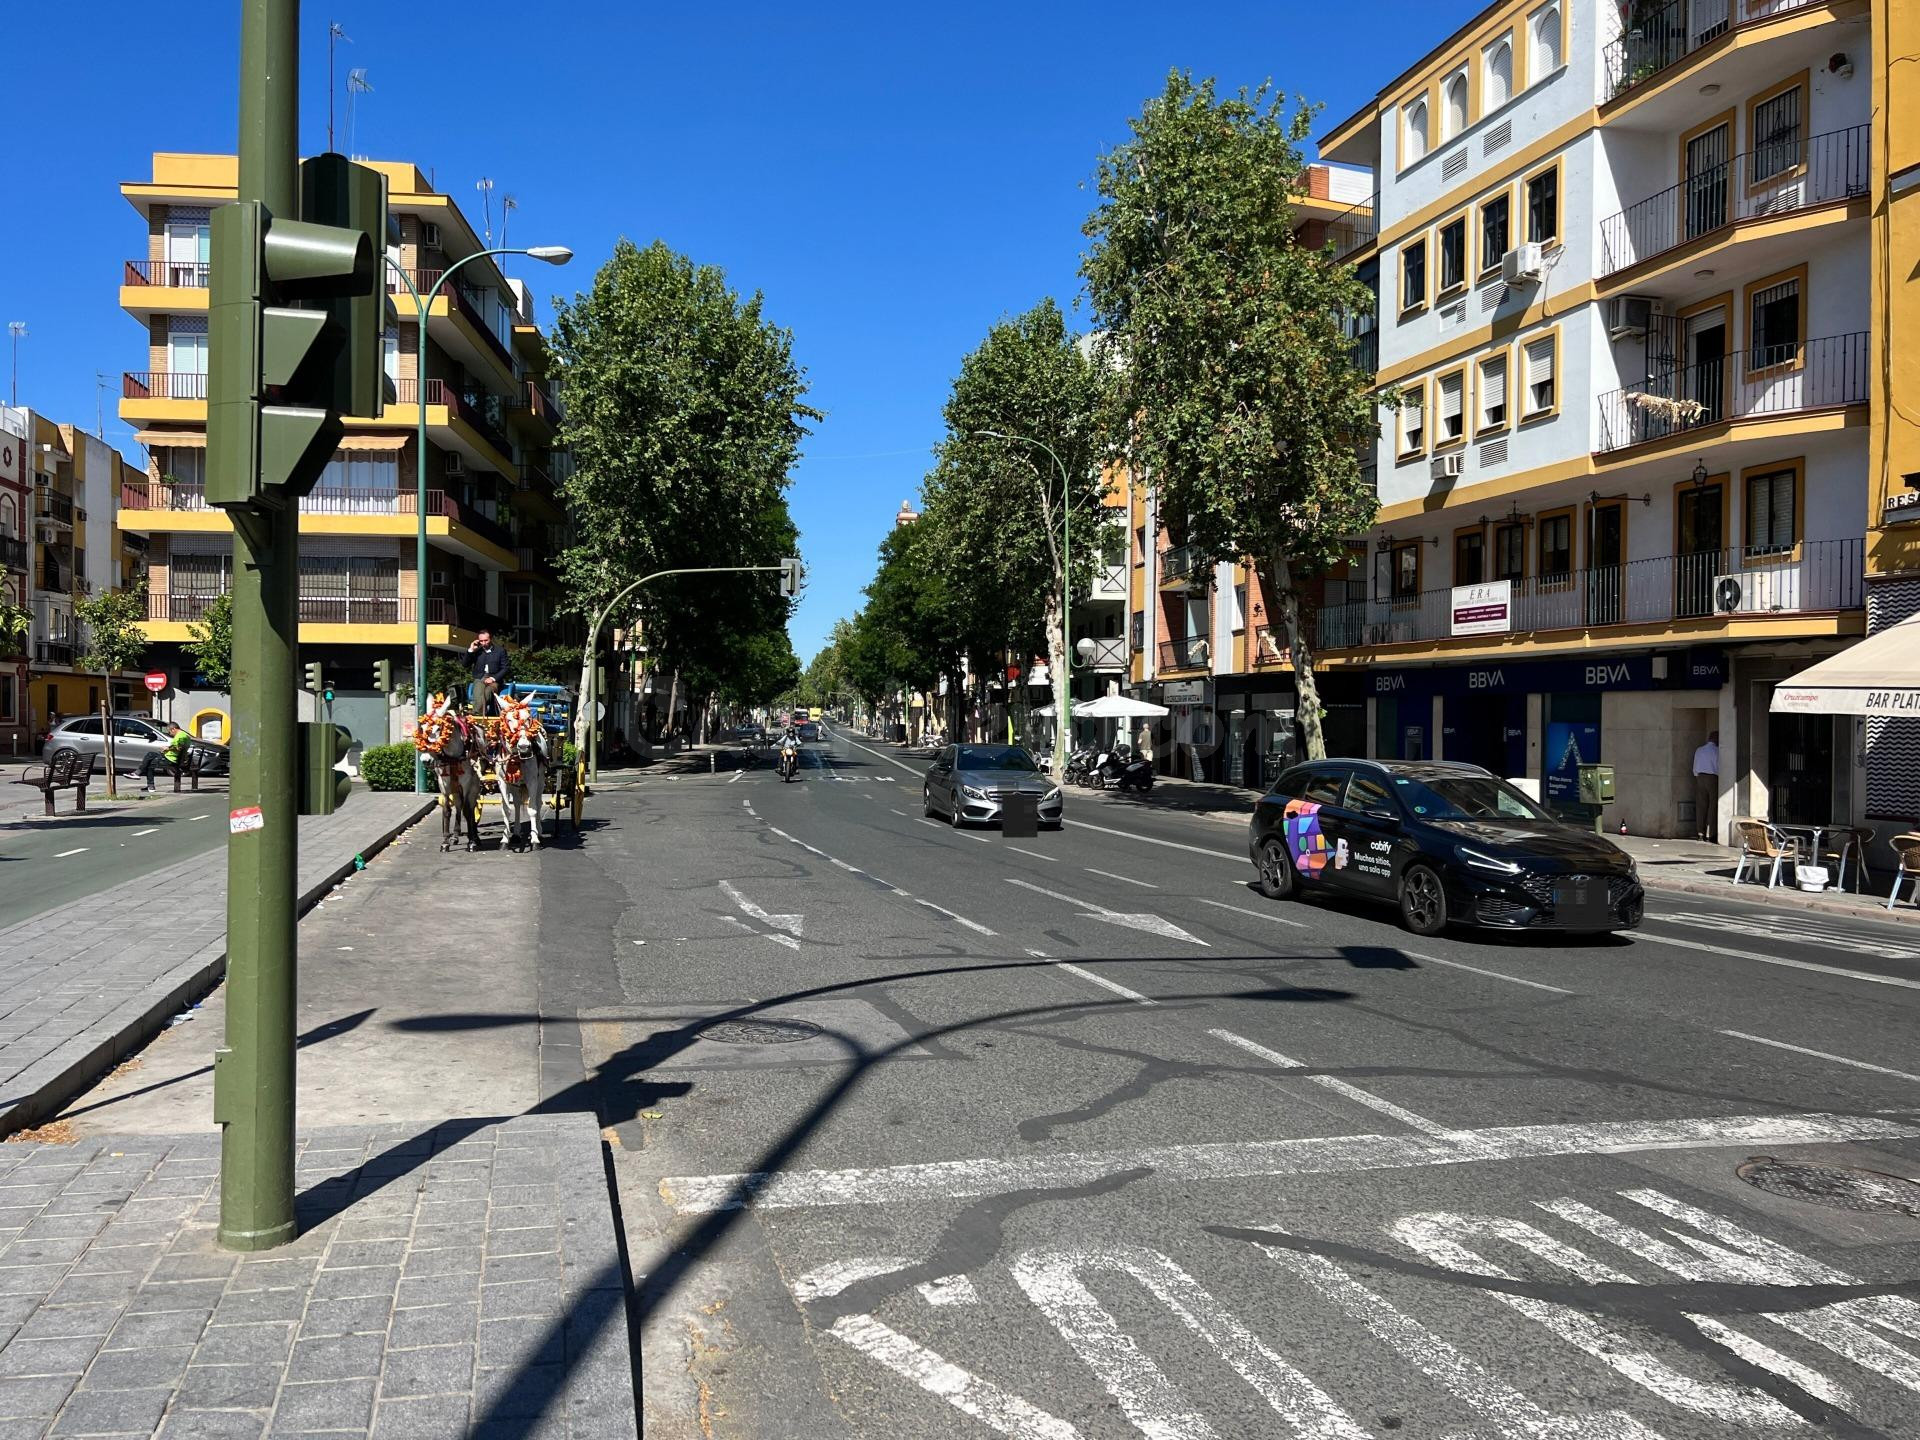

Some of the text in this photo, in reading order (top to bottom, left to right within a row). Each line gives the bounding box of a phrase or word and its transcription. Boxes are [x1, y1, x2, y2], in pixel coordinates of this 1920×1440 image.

[1888, 493, 1920, 508] RES
[1470, 588, 1491, 600] ERA
[1585, 663, 1631, 686] BBVA
[1692, 665, 1719, 675] BBVA
[1376, 675, 1405, 692] BBVA
[1469, 669, 1504, 689] BBVA
[1866, 692, 1920, 709] BAR PLAT
[1370, 840, 1392, 854] cabify
[1354, 851, 1375, 863] Muchos
[1358, 864, 1369, 872] una
[1381, 869, 1391, 878] app
